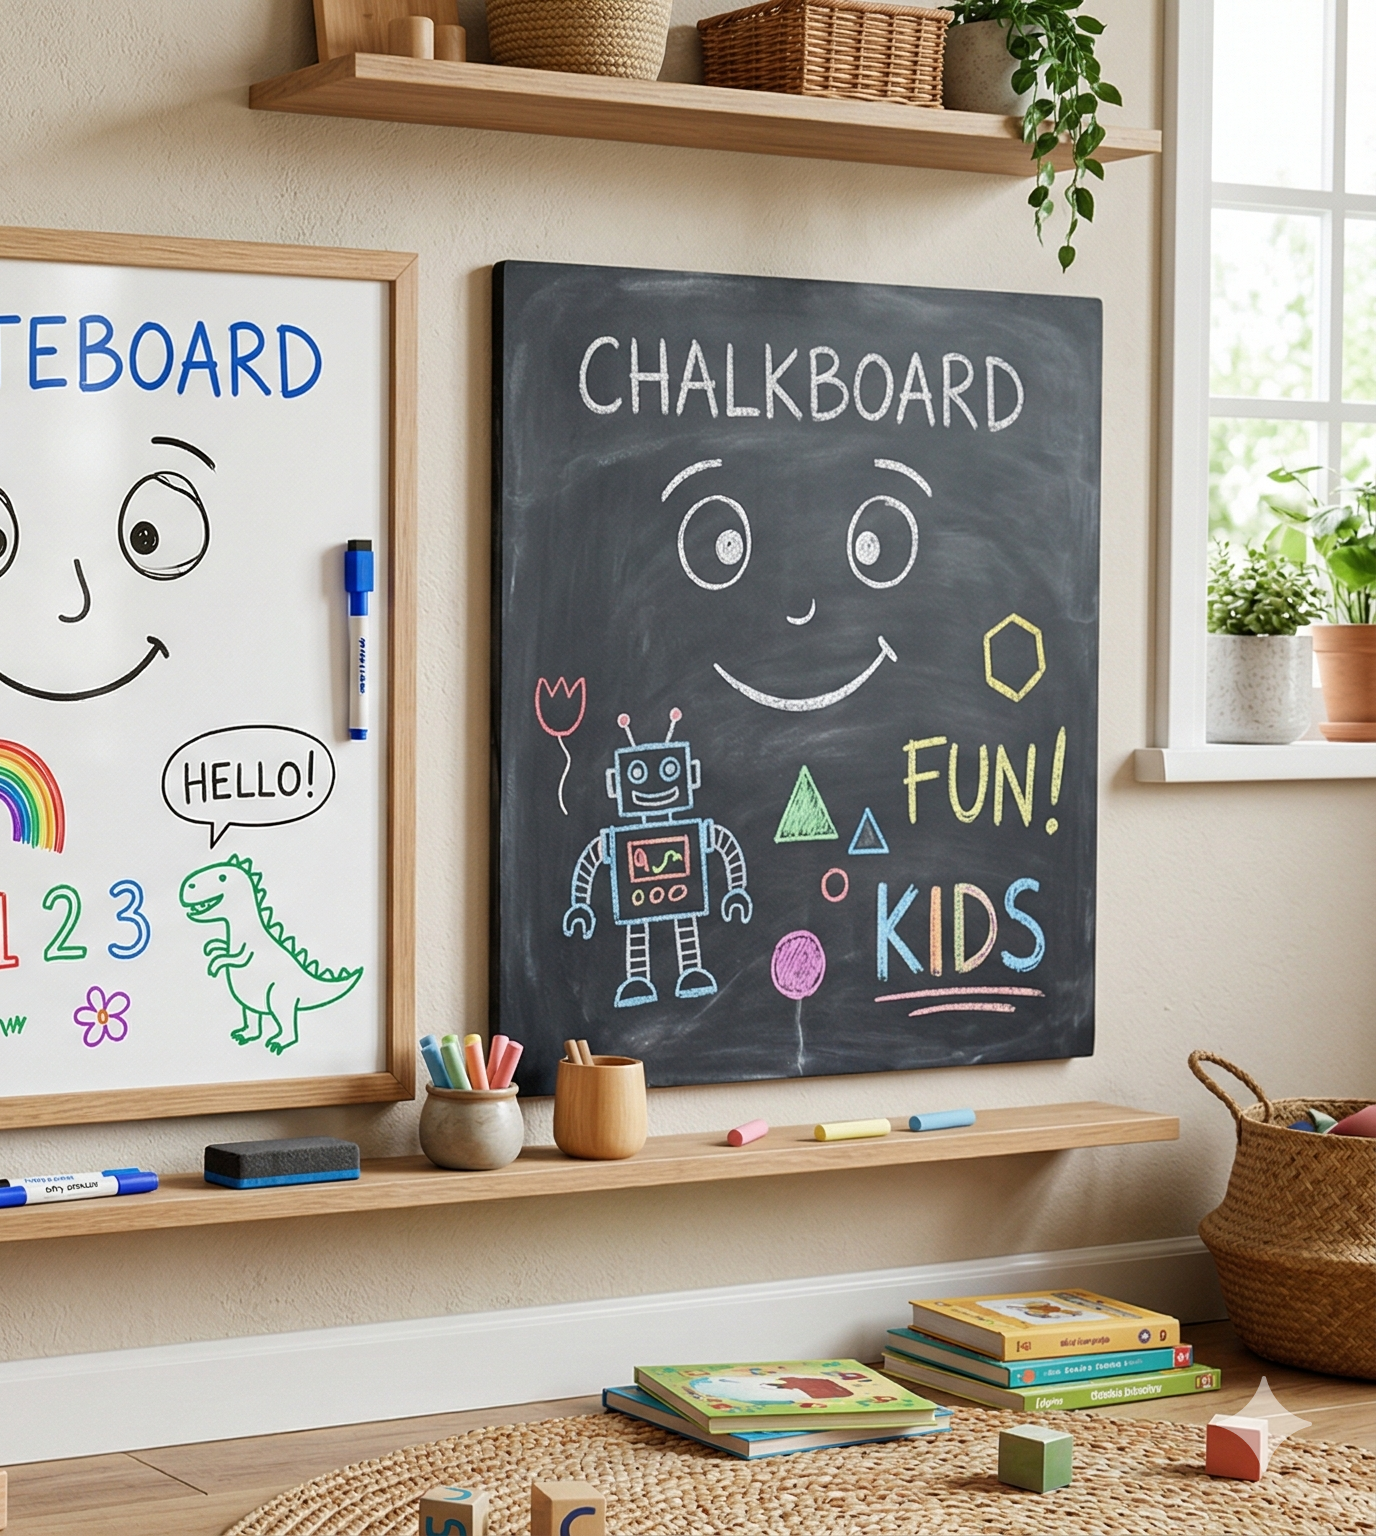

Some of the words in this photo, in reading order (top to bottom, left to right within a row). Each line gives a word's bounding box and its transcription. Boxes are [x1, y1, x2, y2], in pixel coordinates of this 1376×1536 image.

[578, 335, 1026, 433] CHALKBOARD
[184, 750, 317, 805] HELLO!
[903, 726, 1067, 835] FUN!
[876, 878, 1045, 982] KIDS
